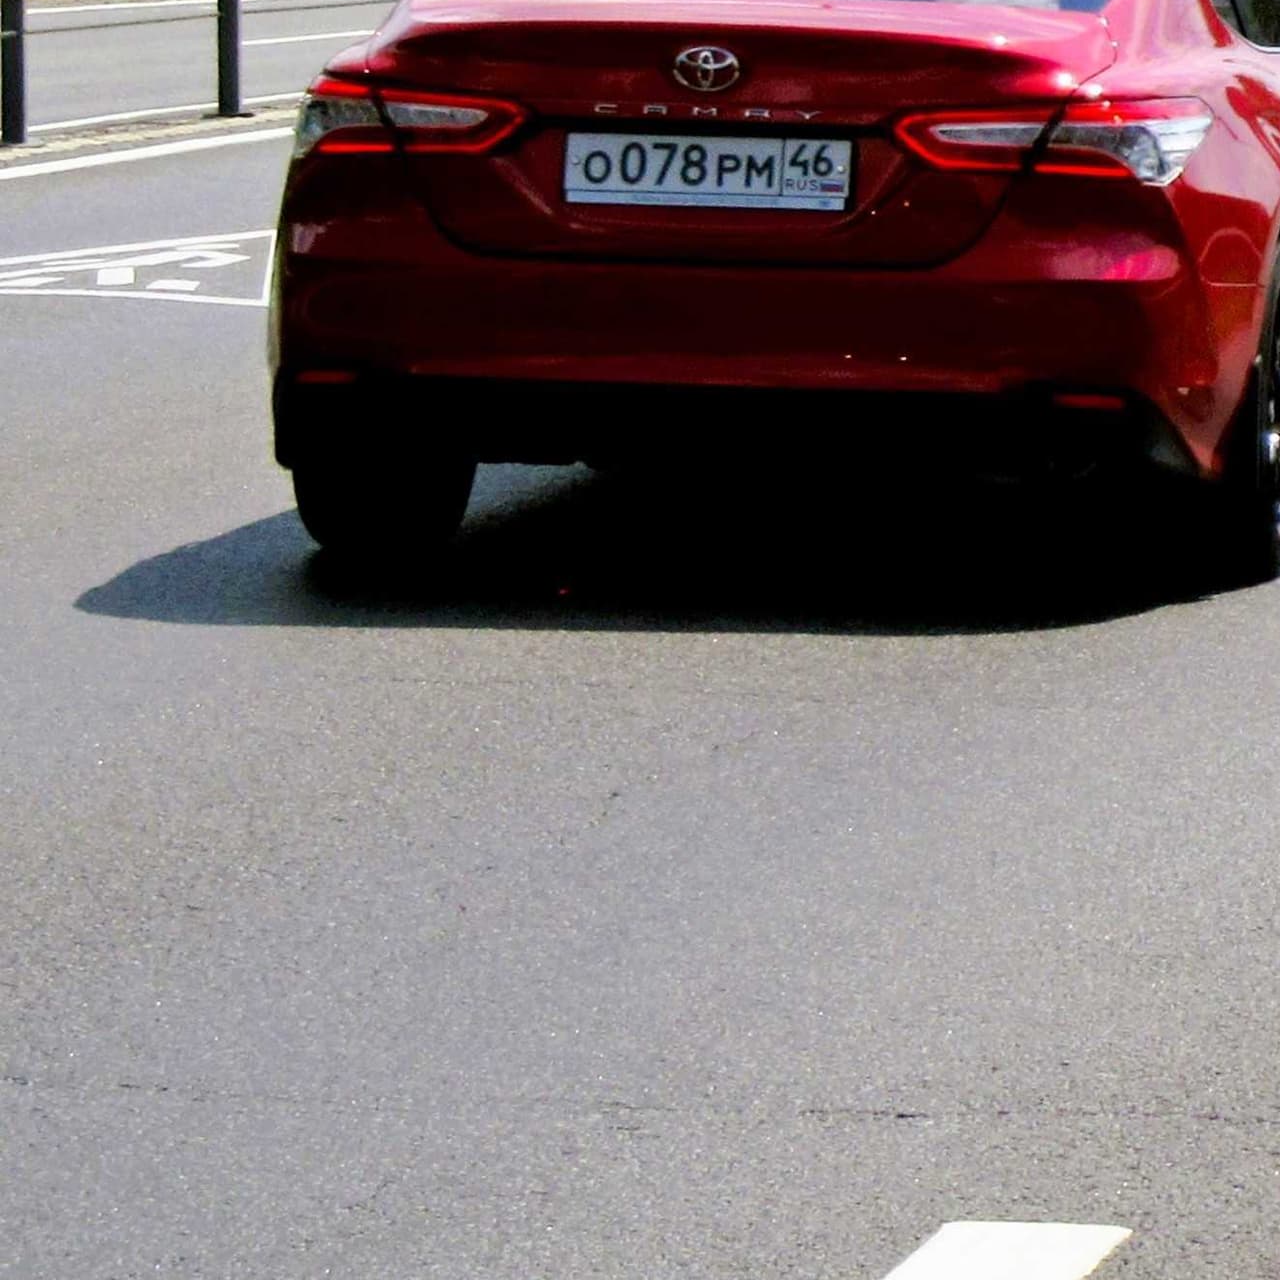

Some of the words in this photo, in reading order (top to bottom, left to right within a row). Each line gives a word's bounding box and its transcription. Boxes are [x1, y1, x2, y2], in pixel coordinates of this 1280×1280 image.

[594, 103, 822, 119] CAMRY
[788, 143, 834, 177] 46
[784, 177, 819, 192] RUS
